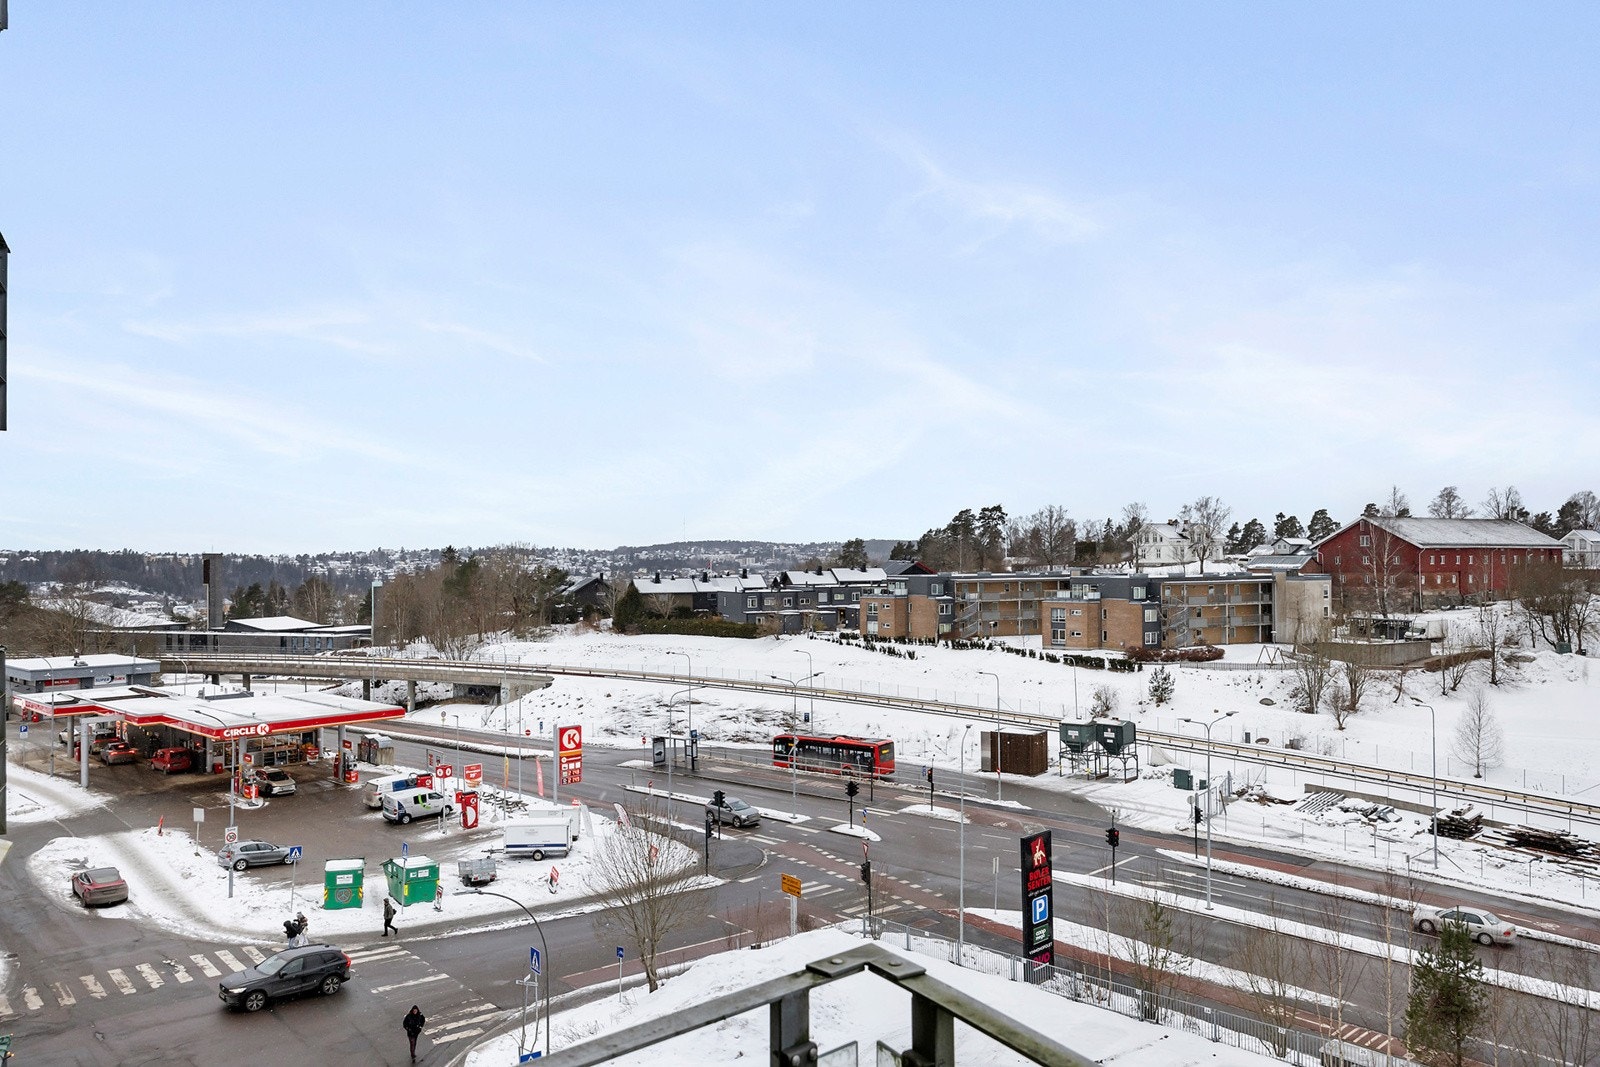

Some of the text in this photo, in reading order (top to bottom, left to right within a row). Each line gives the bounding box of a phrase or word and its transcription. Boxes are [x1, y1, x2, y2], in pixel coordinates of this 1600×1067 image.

[223, 726, 256, 737] CIRCLE
[1027, 875, 1051, 891] SENTER
[1036, 898, 1045, 920] P
[1036, 928, 1046, 936] coop
